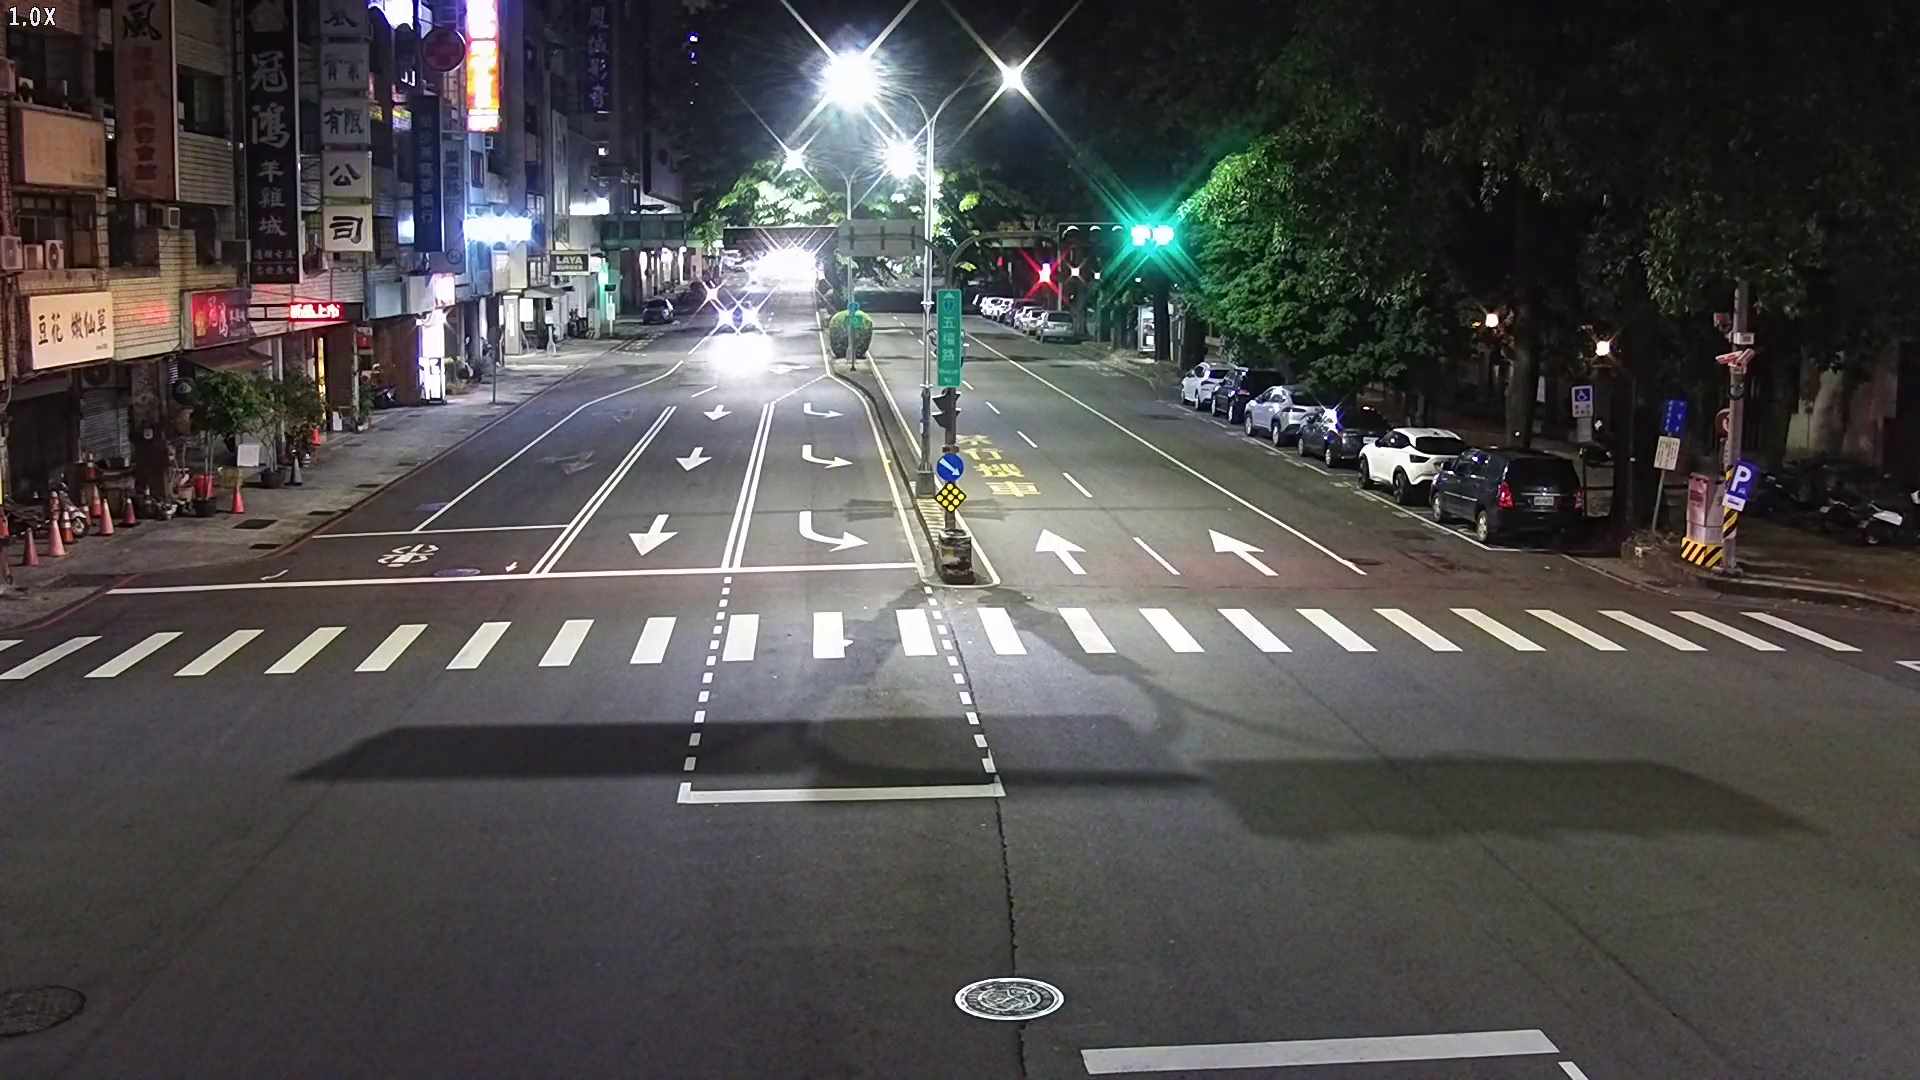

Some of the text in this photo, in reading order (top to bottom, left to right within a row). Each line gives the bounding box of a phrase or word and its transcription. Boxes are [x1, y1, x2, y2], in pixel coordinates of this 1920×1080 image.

[555, 255, 583, 265] LAYA
[38, 312, 65, 346] 豆花
[942, 316, 957, 361] 五福路
[1730, 465, 1752, 493] P
